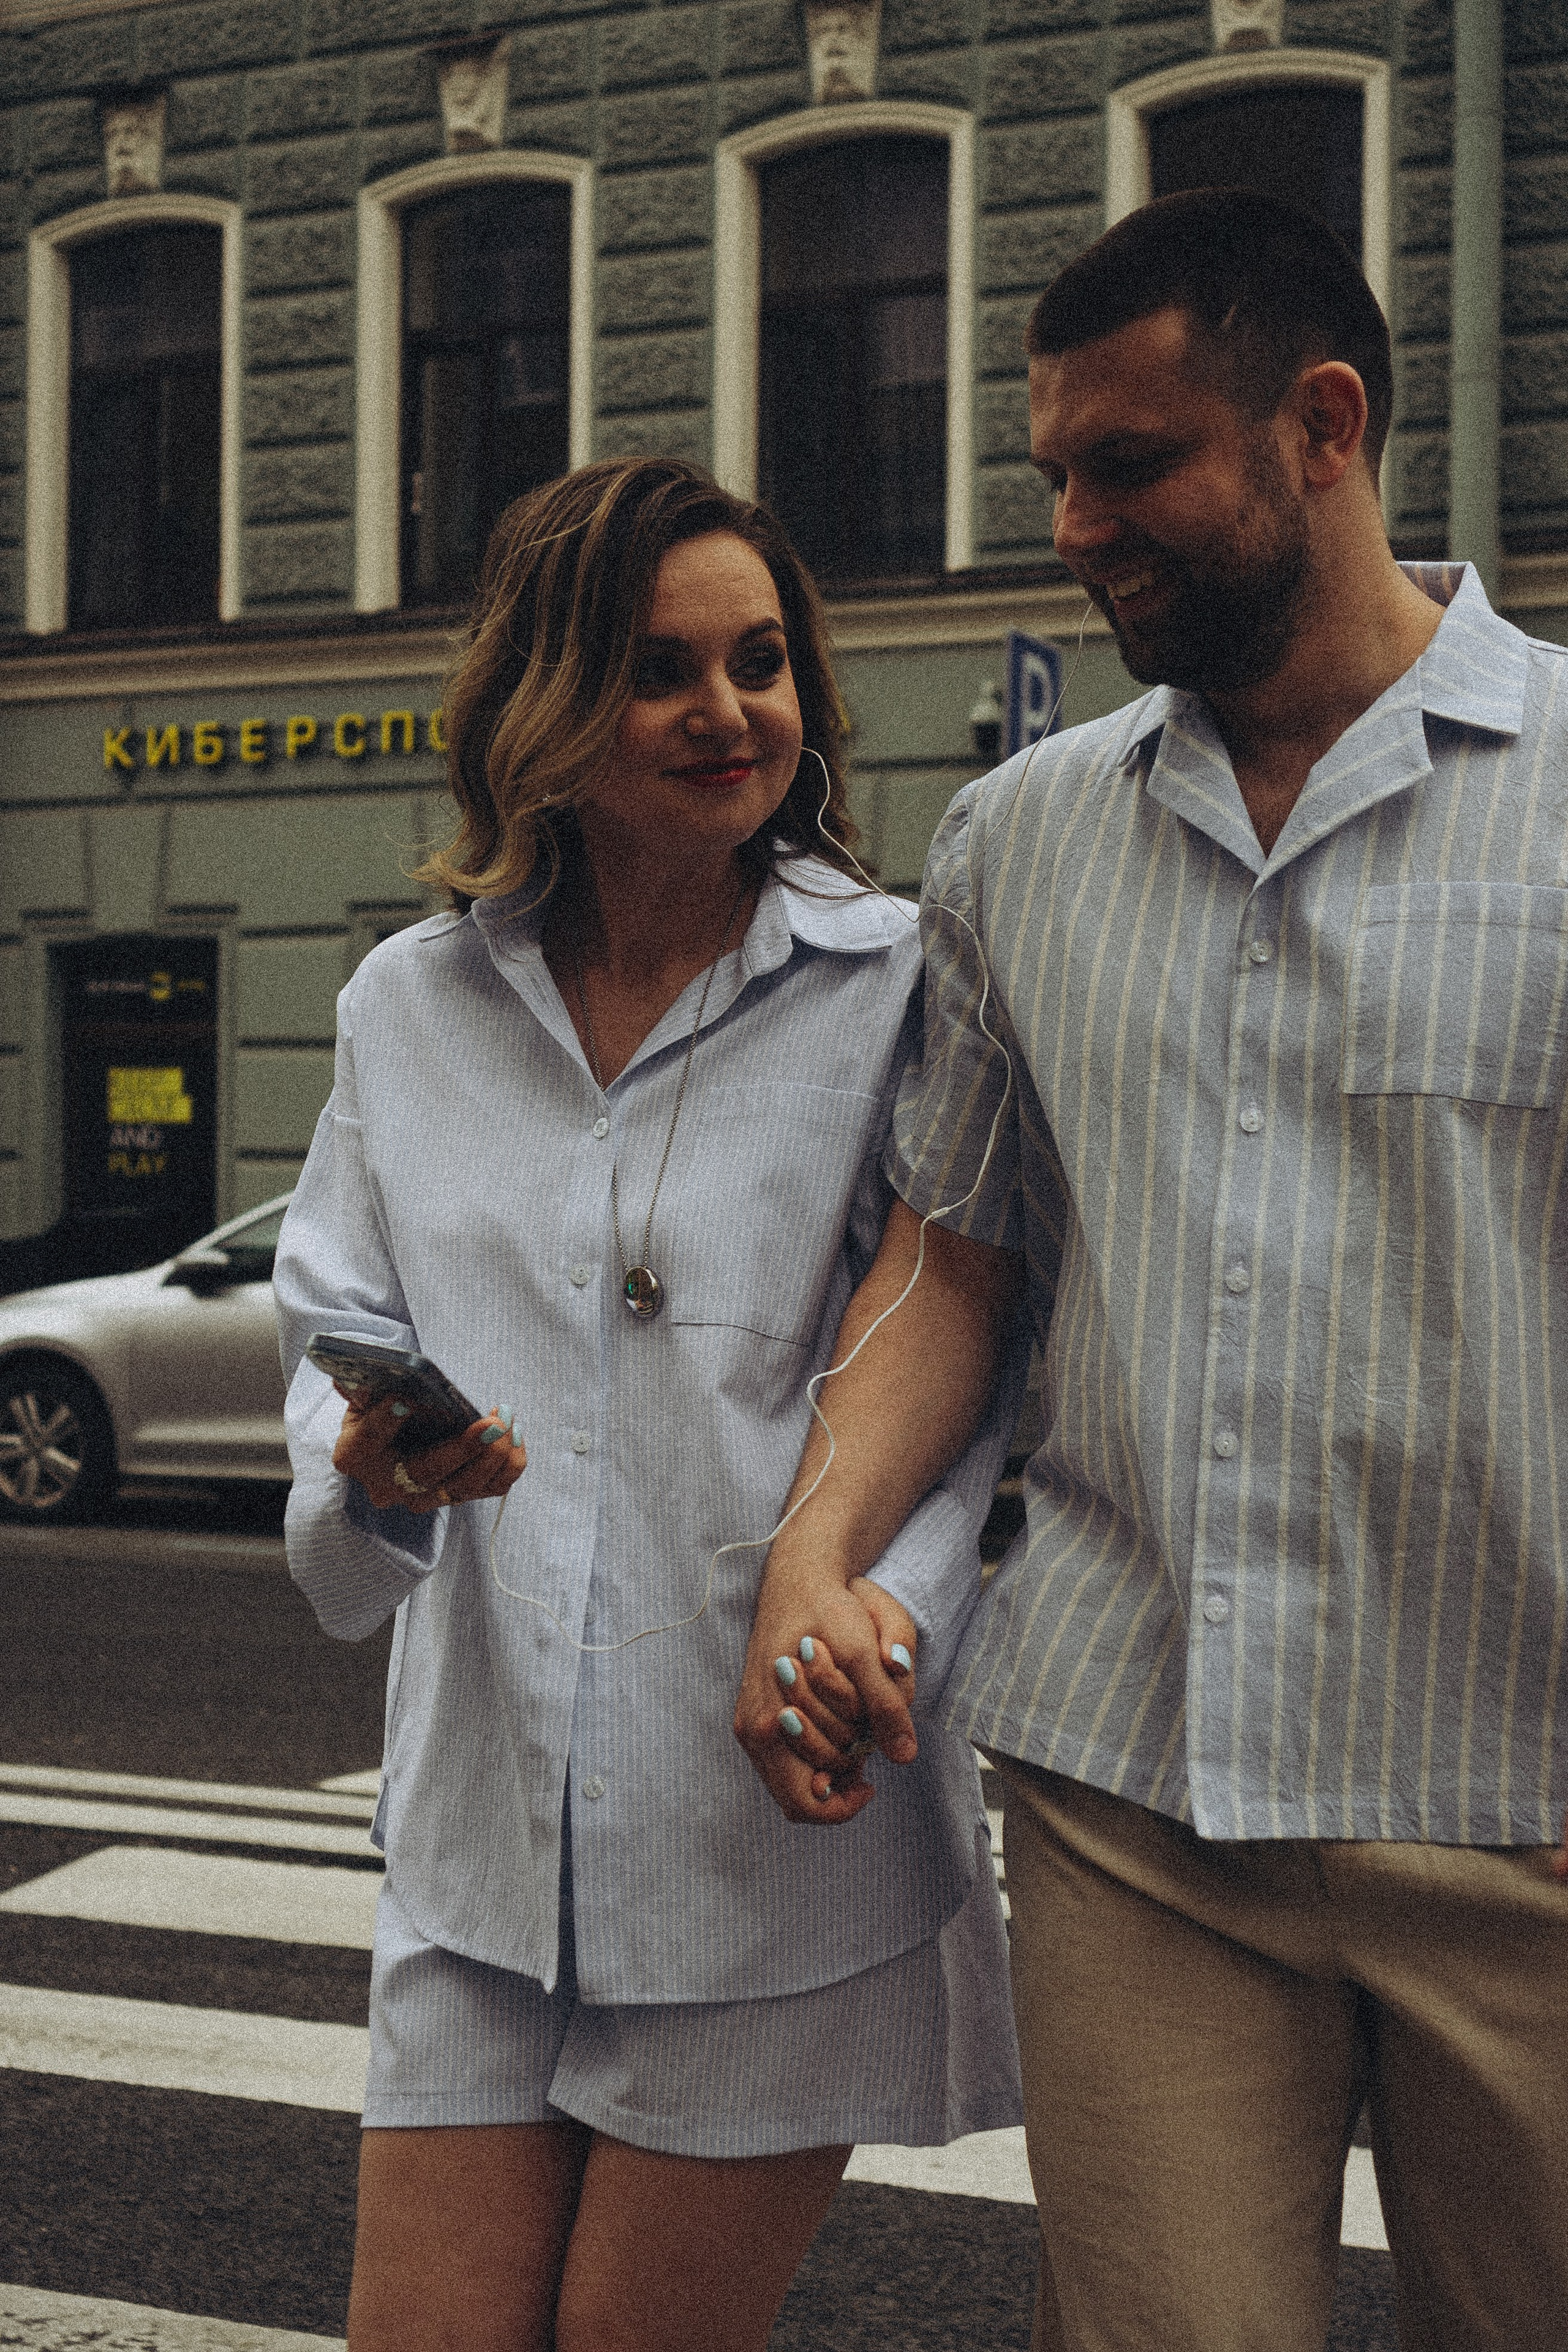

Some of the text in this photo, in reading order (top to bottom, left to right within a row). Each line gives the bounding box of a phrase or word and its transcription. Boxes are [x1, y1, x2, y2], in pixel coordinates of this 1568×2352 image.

[1021, 652, 1052, 750] P
[110, 1126, 162, 1148] AND
[107, 1152, 169, 1177] PLAY
